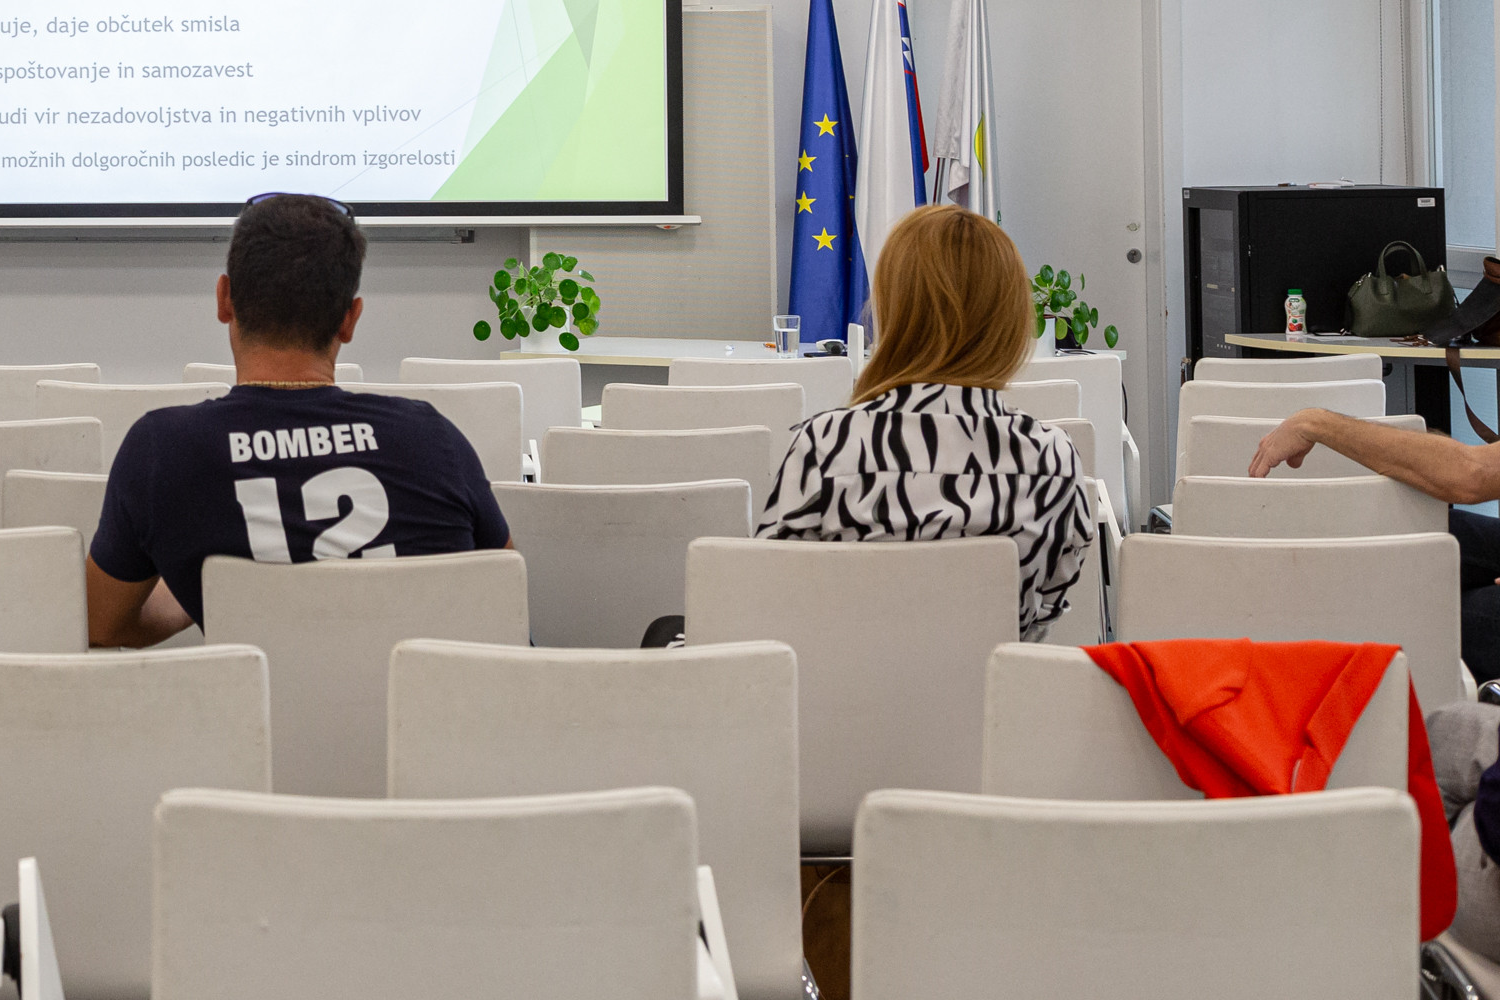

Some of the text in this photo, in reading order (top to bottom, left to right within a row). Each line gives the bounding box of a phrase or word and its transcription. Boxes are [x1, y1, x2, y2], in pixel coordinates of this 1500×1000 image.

[46, 16, 90, 38] daje
[96, 14, 175, 33] občutek
[180, 15, 240, 33] smisla
[117, 61, 135, 79] in
[141, 61, 254, 79] samozavest
[34, 107, 61, 125] vir
[67, 106, 212, 129] nezadovoljstva
[219, 105, 237, 124] in
[244, 104, 346, 128] negativnih
[352, 104, 422, 127] vplivov
[1, 150, 66, 169] možnih
[71, 149, 176, 172] dolgoročnih
[182, 150, 256, 172] posledic
[260, 150, 280, 171] je
[285, 149, 357, 167] sindrom
[362, 149, 456, 170] izgorelosti
[228, 422, 379, 463] BOMBER
[233, 466, 397, 564] 12
